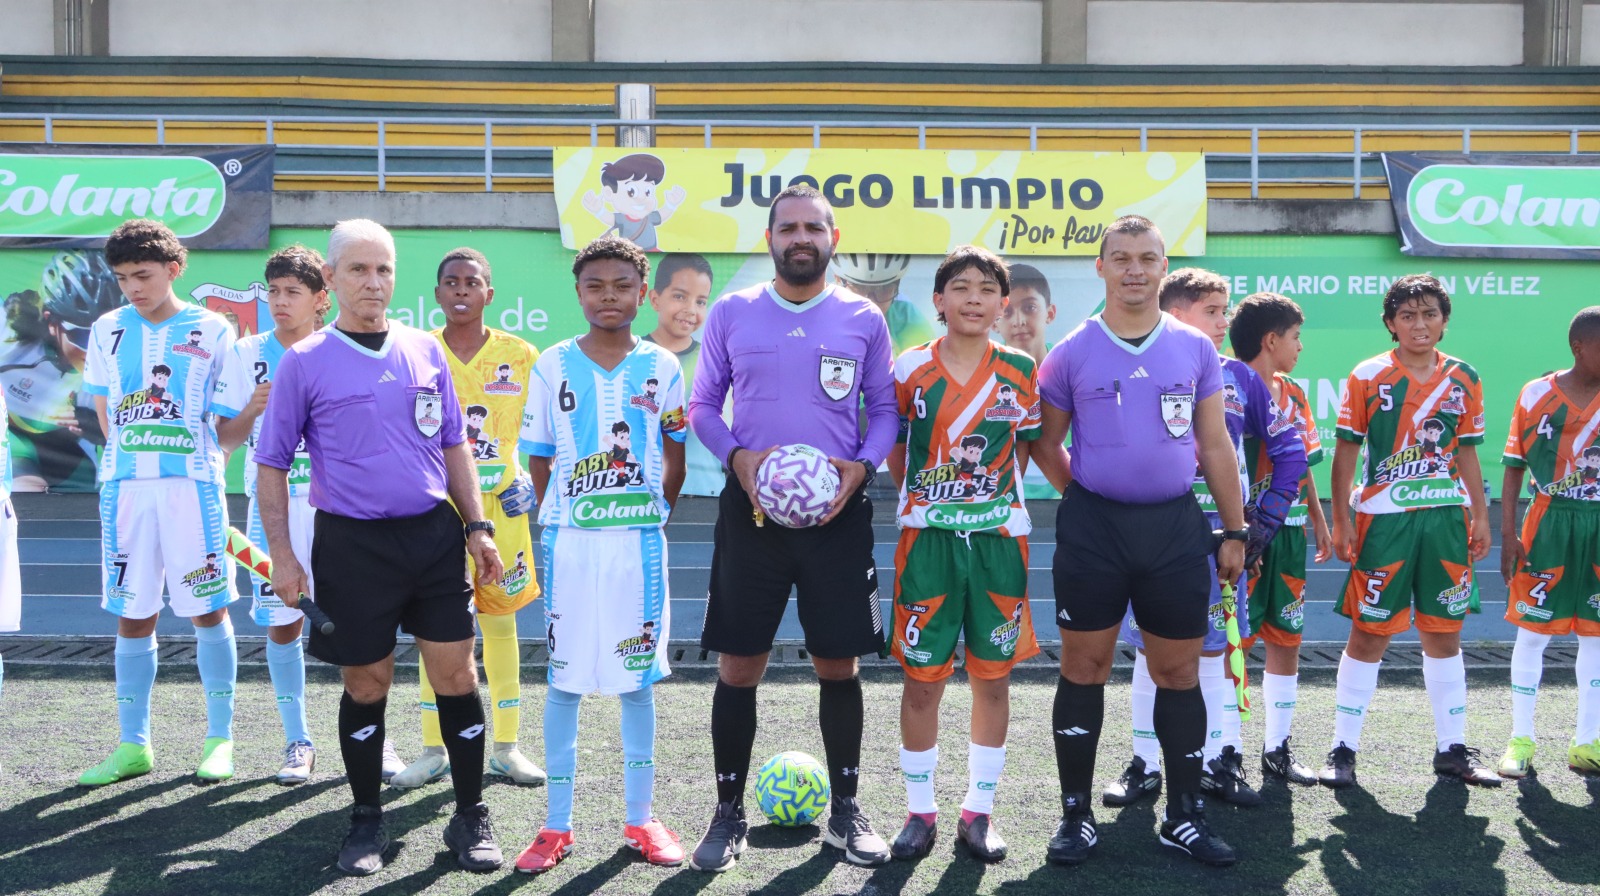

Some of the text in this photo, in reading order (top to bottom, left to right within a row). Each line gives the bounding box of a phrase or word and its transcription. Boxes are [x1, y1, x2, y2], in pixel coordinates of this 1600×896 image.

[720, 162, 893, 209] JUGO
[1415, 178, 1600, 227] Colan
[999, 214, 1109, 250] ¡Por fav
[212, 287, 244, 302] CALDAS
[1256, 275, 1339, 295] MARIO
[1348, 270, 1456, 295] RENN
[1464, 271, 1540, 296] VÉLEZ
[500, 297, 549, 332] de
[110, 328, 126, 356] 7
[254, 361, 268, 384] 2
[822, 358, 855, 368] ARBITRO
[417, 395, 441, 403] ARBITRO
[558, 380, 576, 412] 6
[913, 386, 927, 419] 6
[1378, 383, 1394, 412] 5
[120, 430, 194, 449] Colanta
[1536, 413, 1553, 440] 4
[113, 562, 128, 587] 7
[1364, 578, 1382, 605] 5
[1529, 581, 1547, 606] 4
[913, 605, 926, 613] JMG
[548, 622, 556, 653] 6
[905, 614, 920, 646] 6
[619, 637, 642, 651] BABY
